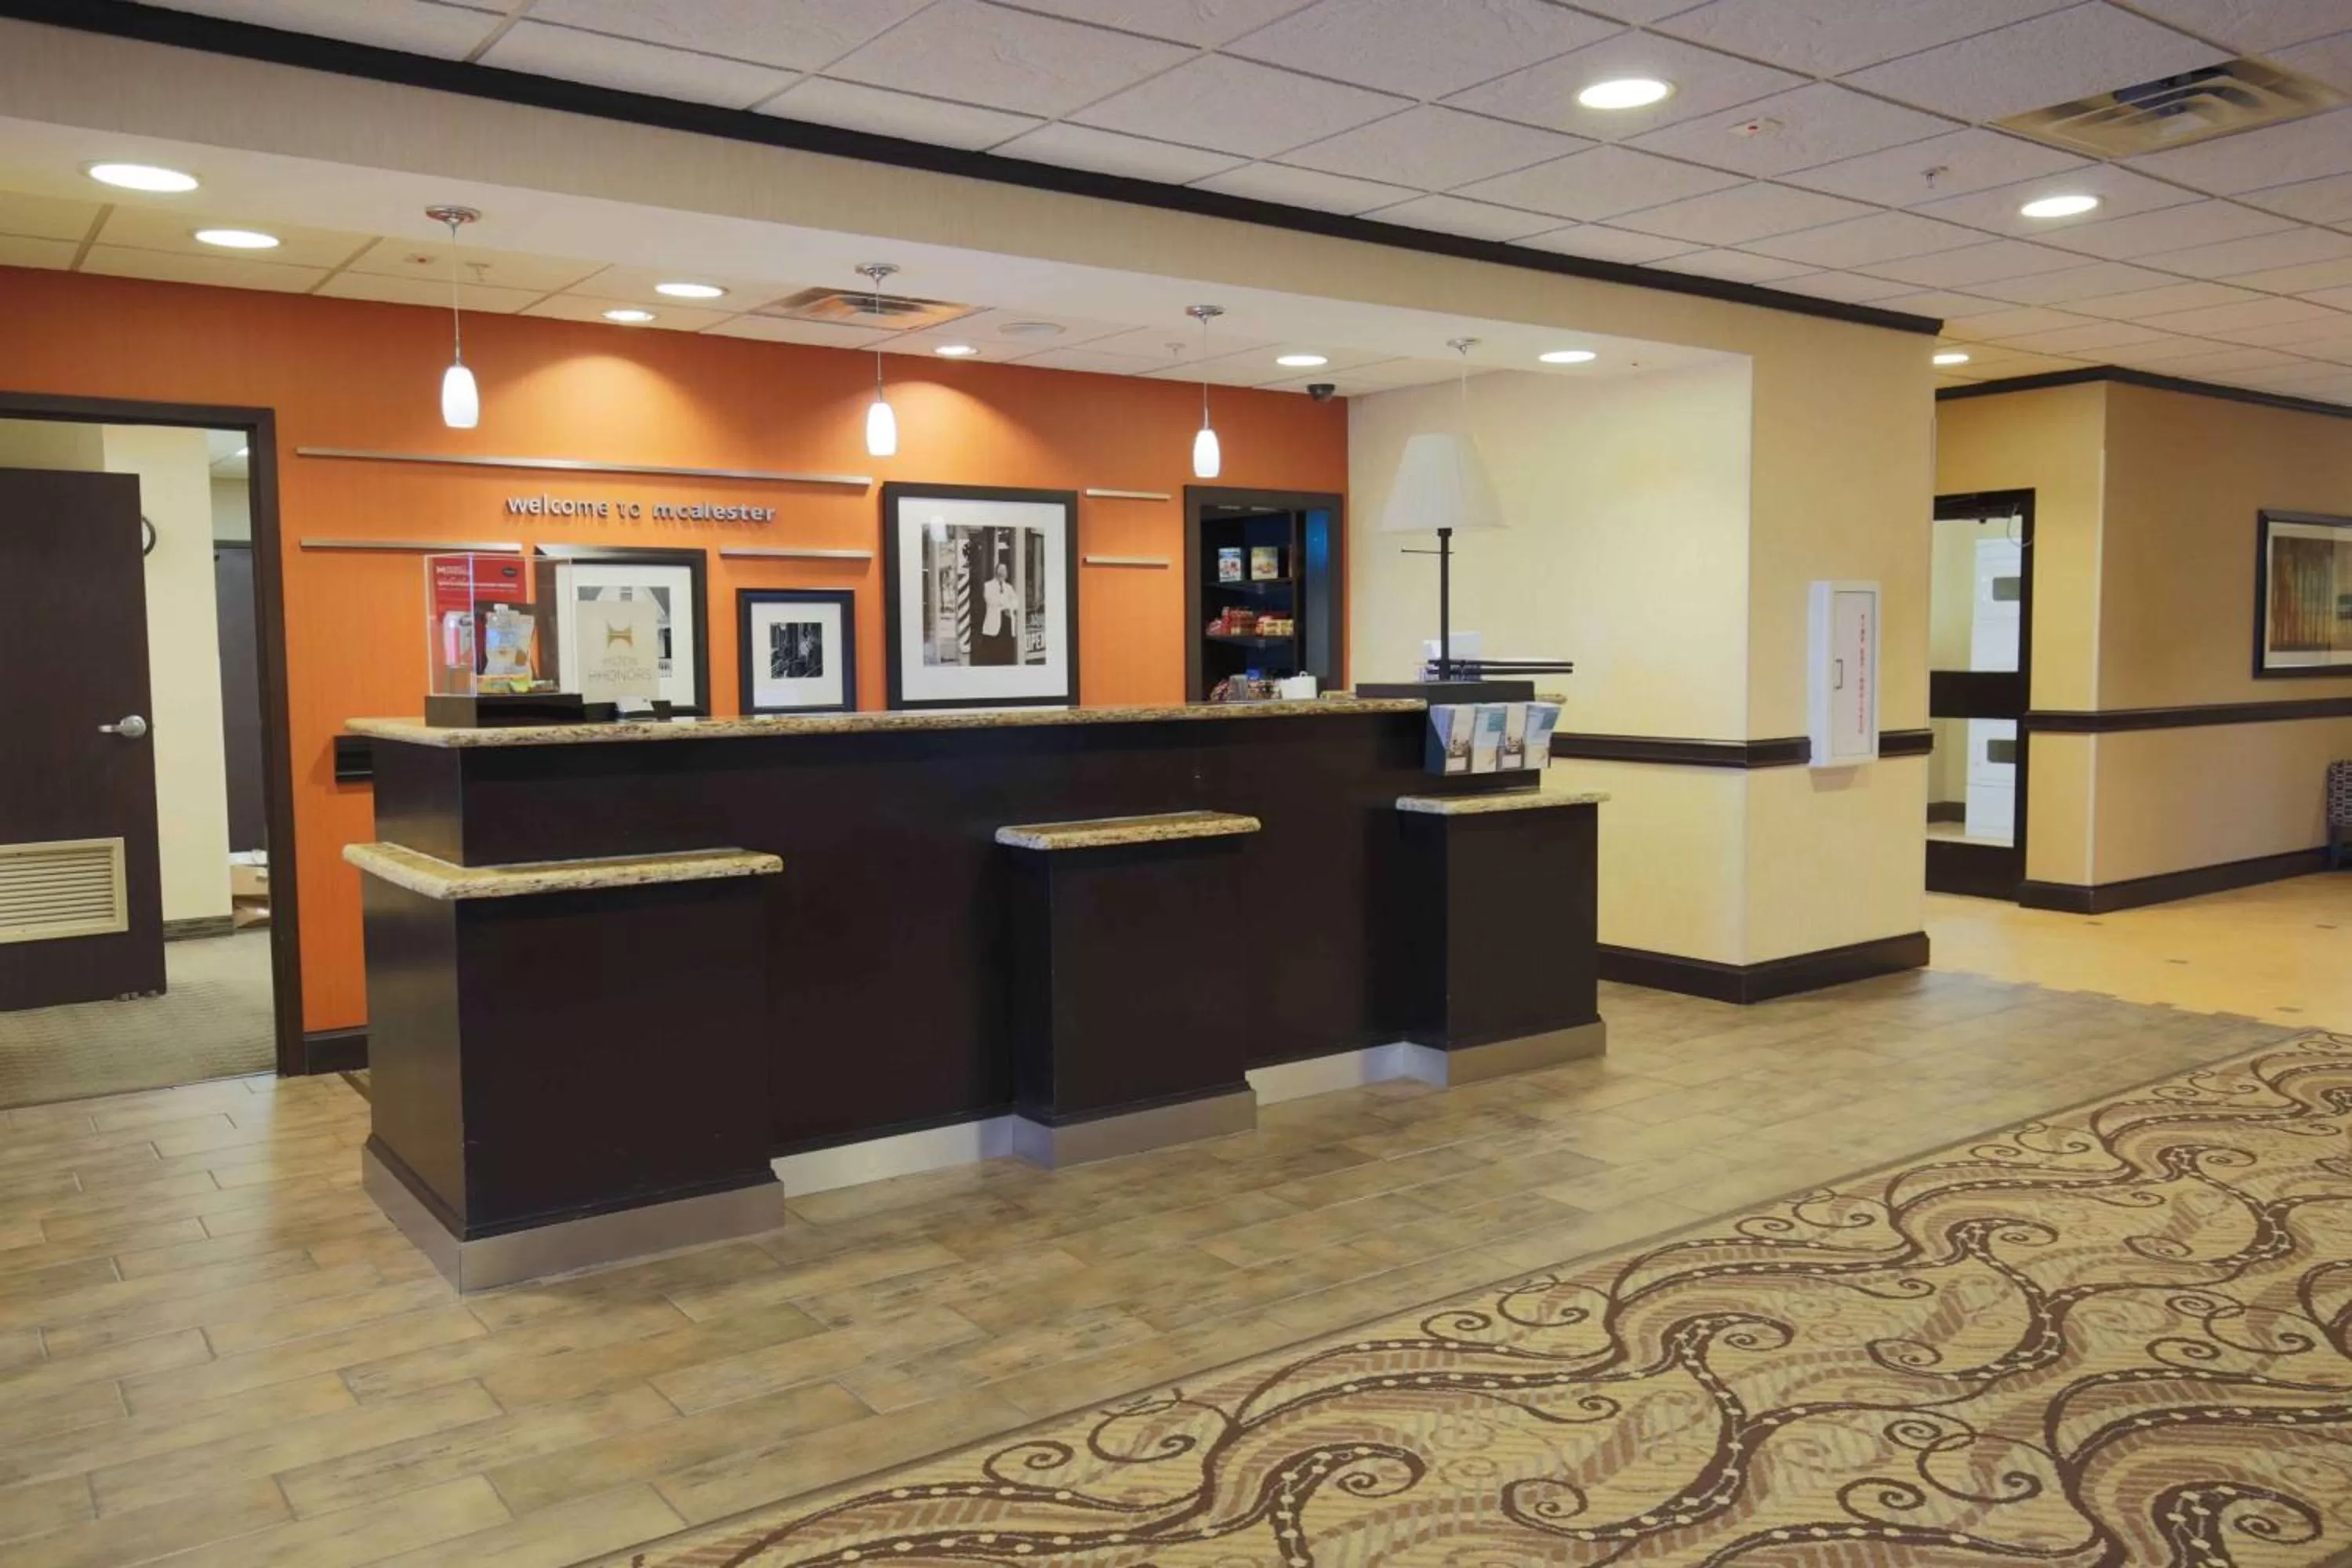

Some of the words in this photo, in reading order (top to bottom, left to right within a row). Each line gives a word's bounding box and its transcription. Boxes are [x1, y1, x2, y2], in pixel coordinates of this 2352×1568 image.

[506, 492, 609, 517] welcome
[616, 502, 641, 520] to
[652, 501, 776, 522] mcalester
